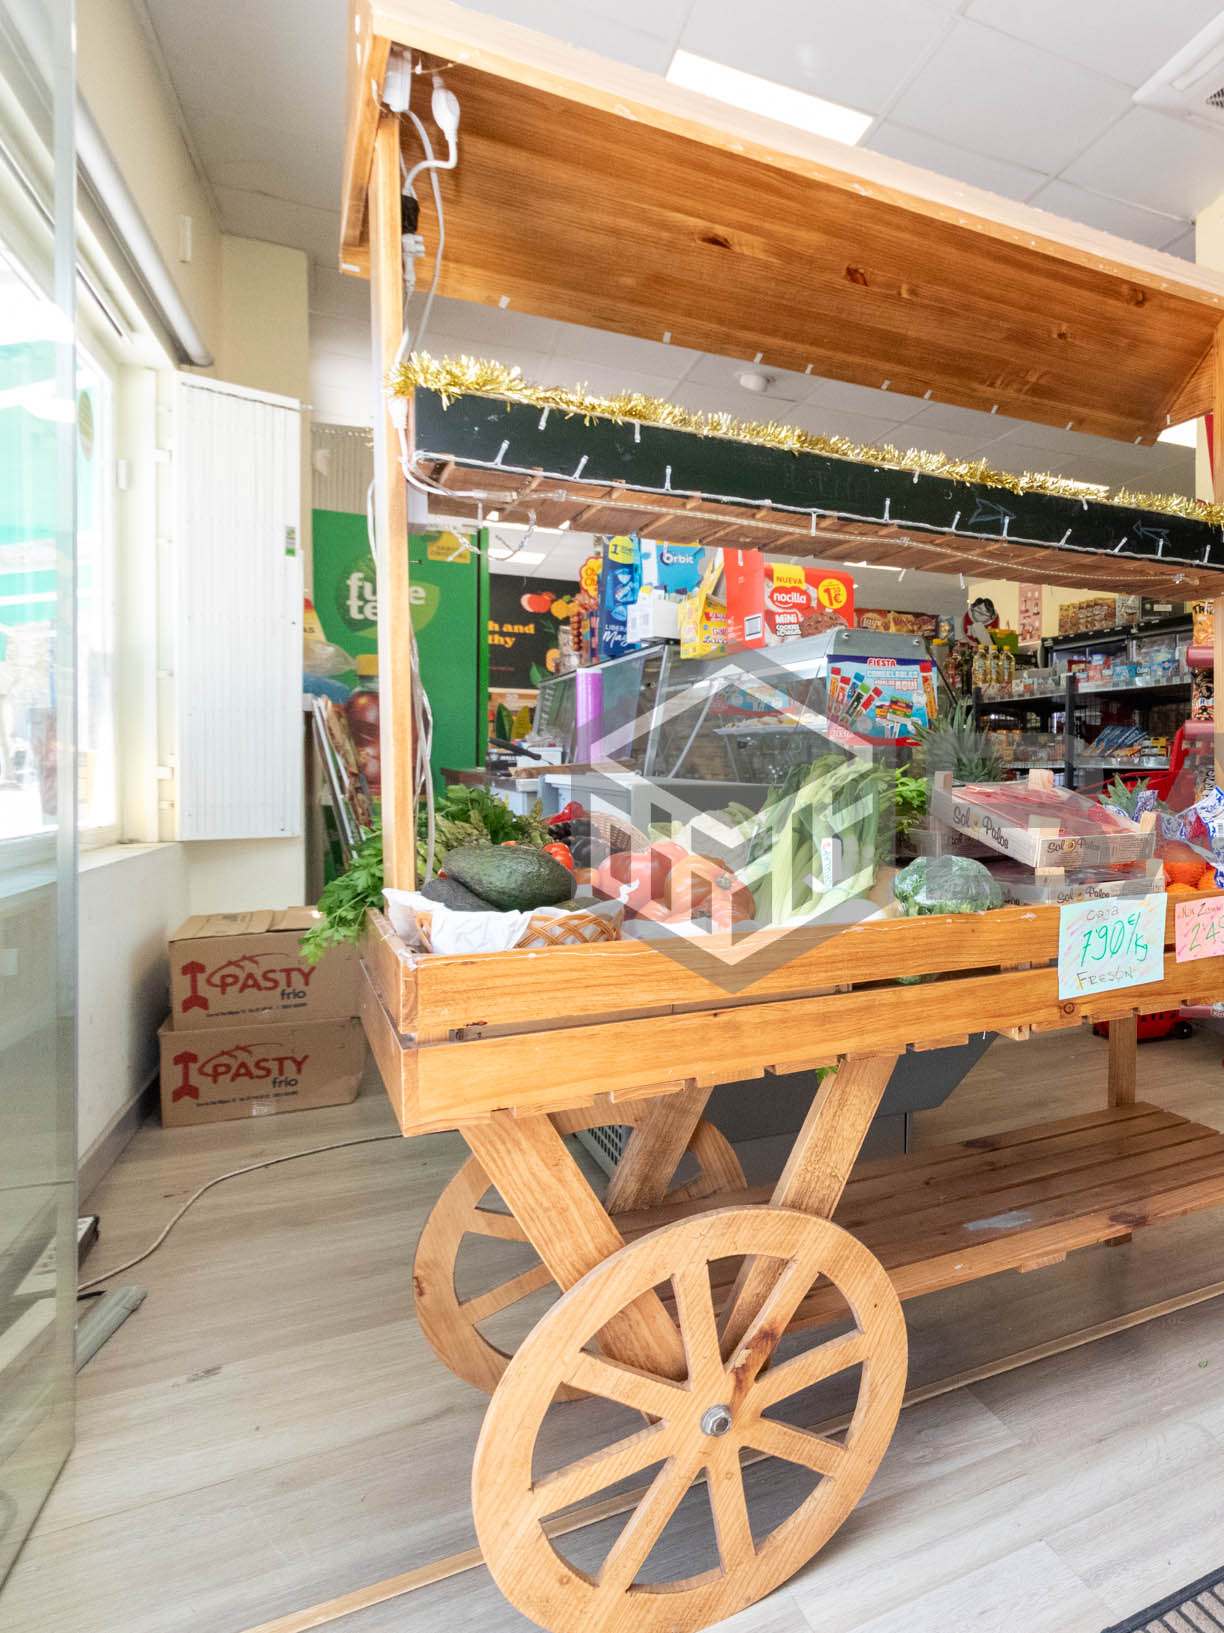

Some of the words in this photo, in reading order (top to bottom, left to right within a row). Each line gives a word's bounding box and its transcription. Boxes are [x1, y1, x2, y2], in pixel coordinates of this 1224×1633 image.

[776, 575, 803, 585] NUEVA
[773, 592, 807, 604] nocilla
[502, 622, 535, 634] and
[868, 658, 896, 668] FIESTA
[953, 806, 971, 829] Sol
[1047, 840, 1066, 855] Sol
[1056, 890, 1075, 904] Sol
[216, 965, 317, 995] PASTY
[209, 1054, 310, 1085] PASTY
